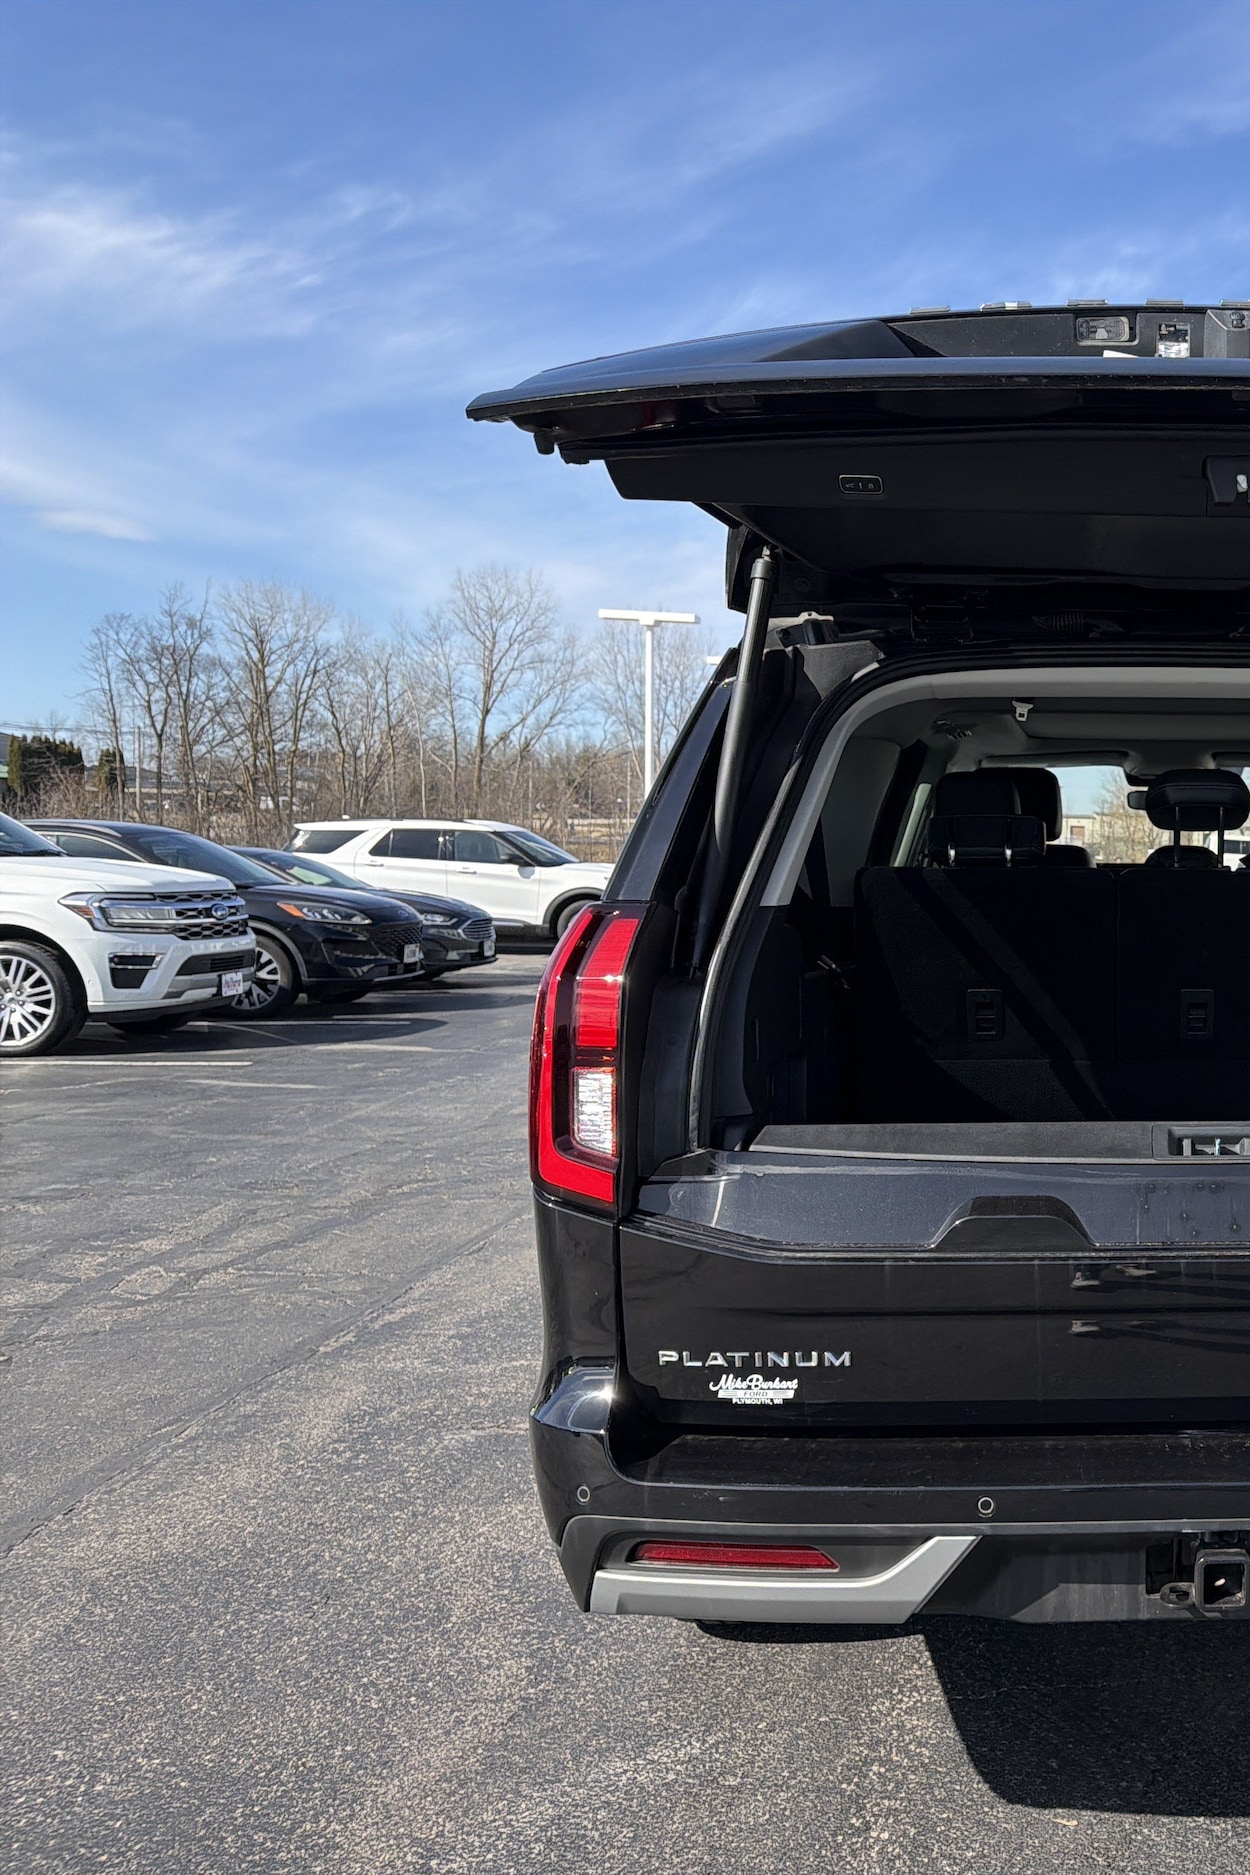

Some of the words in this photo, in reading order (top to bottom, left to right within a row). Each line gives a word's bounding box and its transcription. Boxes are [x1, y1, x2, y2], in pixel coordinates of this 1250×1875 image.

[657, 1350, 852, 1368] PLATINUM
[709, 1373, 747, 1391] Mike
[746, 1373, 799, 1390] Burkart
